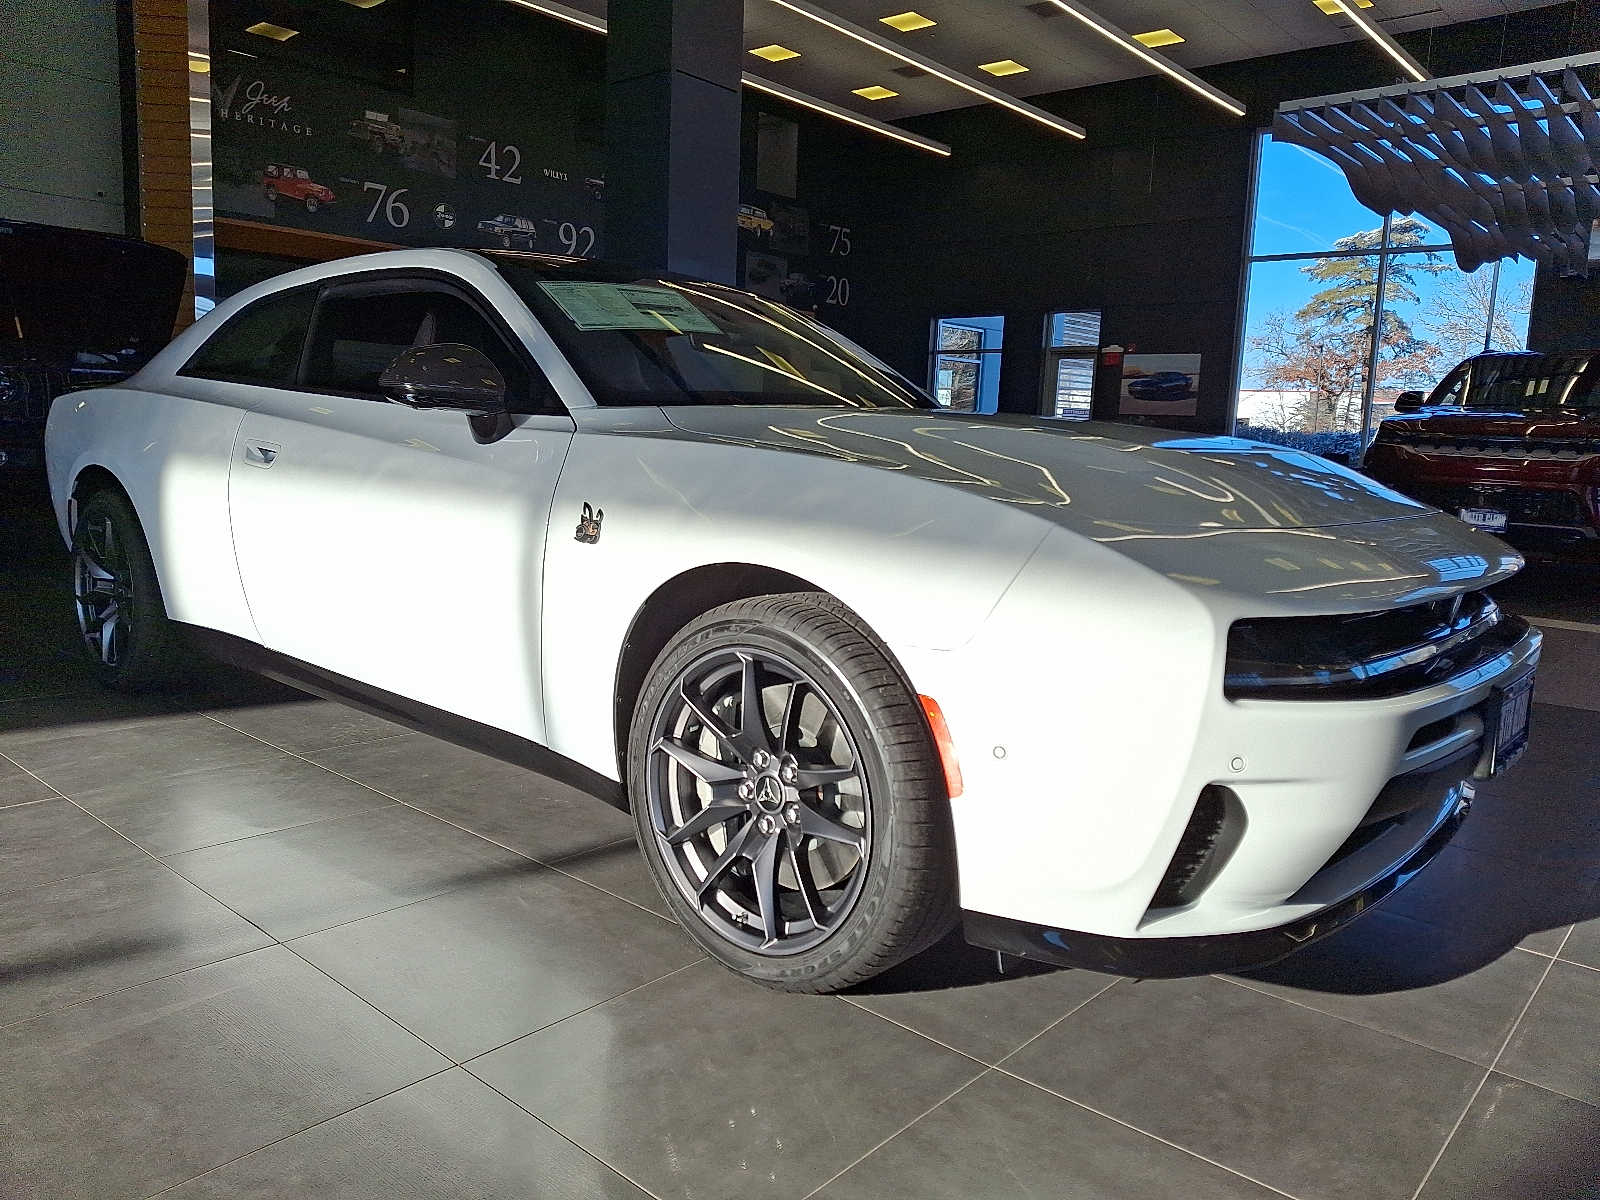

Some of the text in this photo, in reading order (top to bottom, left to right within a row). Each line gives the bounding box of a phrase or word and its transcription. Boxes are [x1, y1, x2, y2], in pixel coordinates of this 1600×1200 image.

[242, 81, 291, 114] Jeep
[221, 109, 313, 136] HERITAGE
[479, 141, 522, 185] 42
[543, 168, 568, 182] WILLYS
[364, 181, 410, 228] 76
[559, 222, 596, 257] 92
[829, 225, 851, 256] 75
[825, 275, 850, 306] 20
